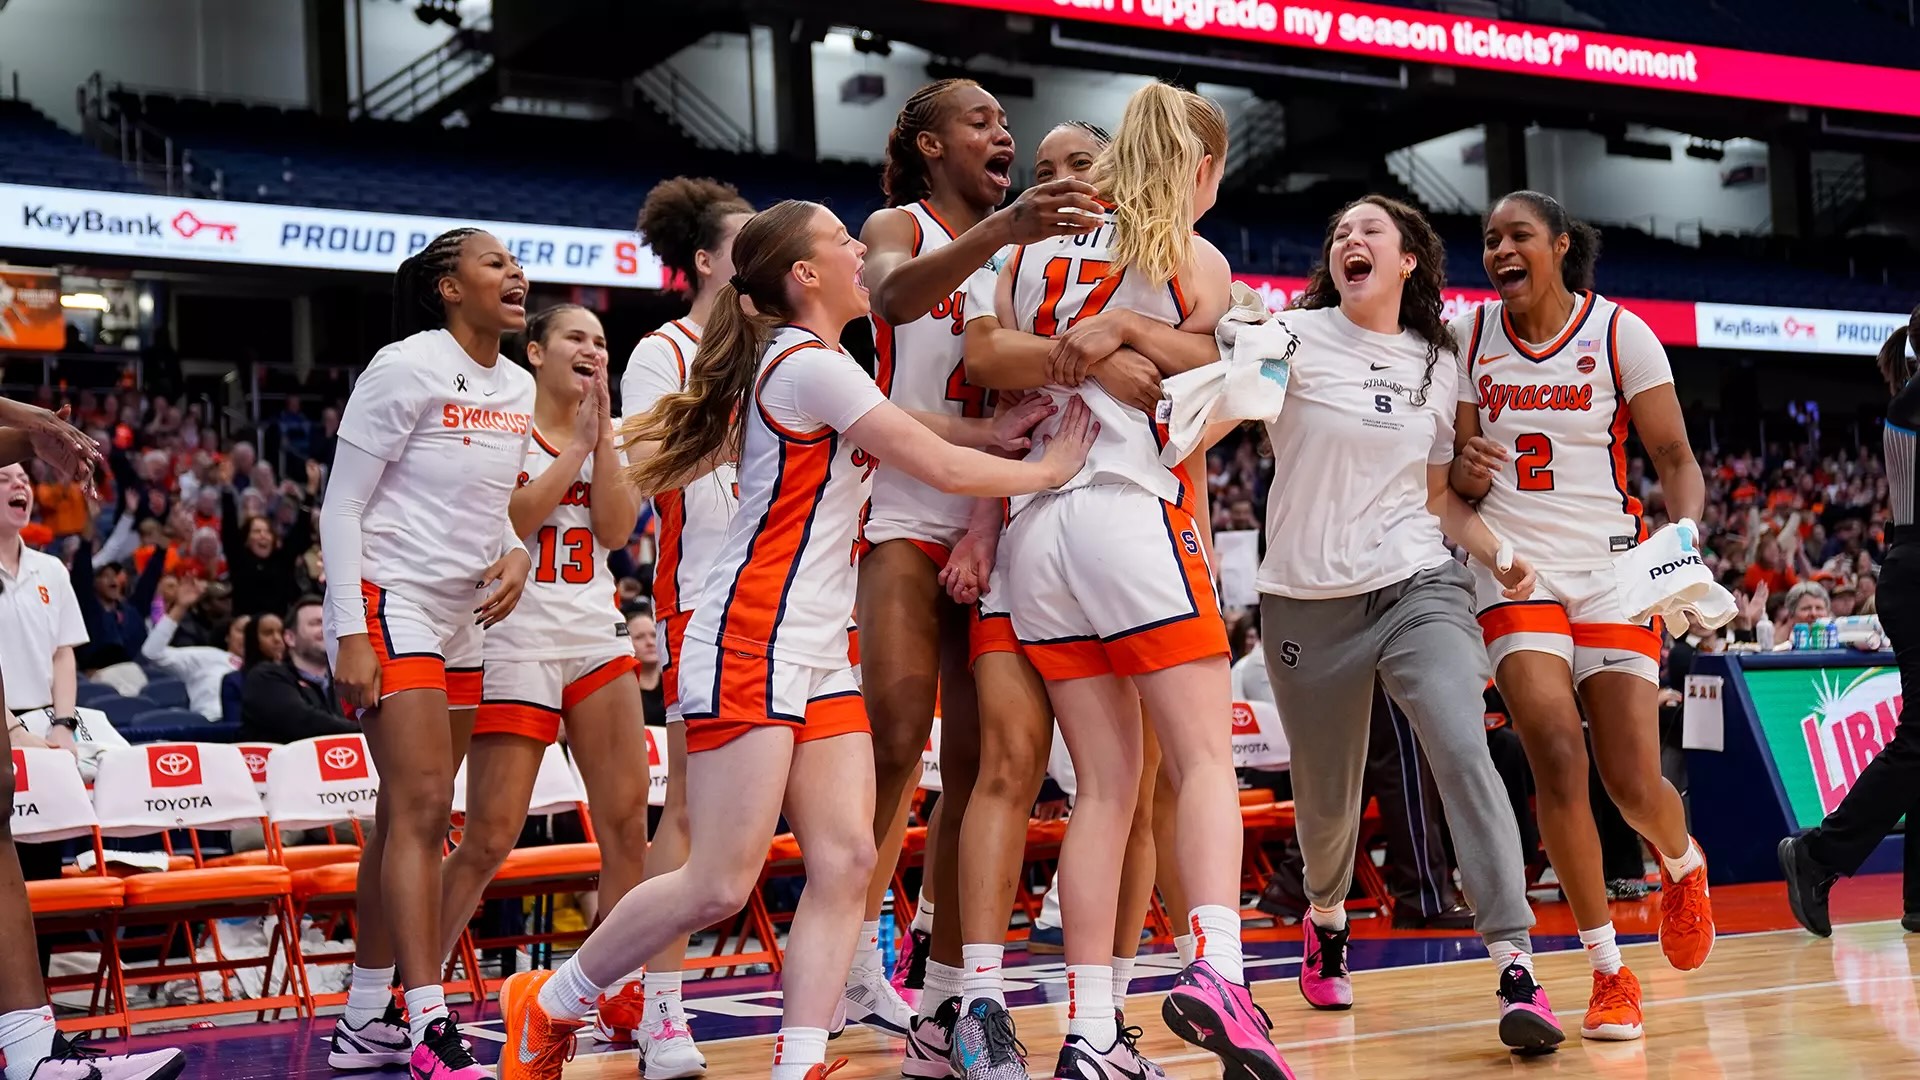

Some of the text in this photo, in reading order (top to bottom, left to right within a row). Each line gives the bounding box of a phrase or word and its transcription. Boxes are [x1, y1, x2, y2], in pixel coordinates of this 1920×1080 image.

[1284, 6, 1332, 45] my
[1338, 13, 1447, 51] season
[1585, 43, 1697, 82] moment
[23, 205, 162, 237] KeyBank
[281, 223, 396, 254] PROUD
[565, 243, 605, 268] OF
[1032, 255, 1127, 337] 17
[1363, 378, 1404, 397] SYRACUSE
[1478, 374, 1593, 423] Syracuse
[1375, 394, 1392, 414] S
[1515, 432, 1555, 491] 2
[535, 525, 594, 584] 13
[1181, 530, 1199, 555] S
[1281, 640, 1301, 670] S
[1232, 743, 1269, 754] OYOTA
[144, 795, 212, 812] TOYOTA
[316, 788, 378, 806] TOYOTA
